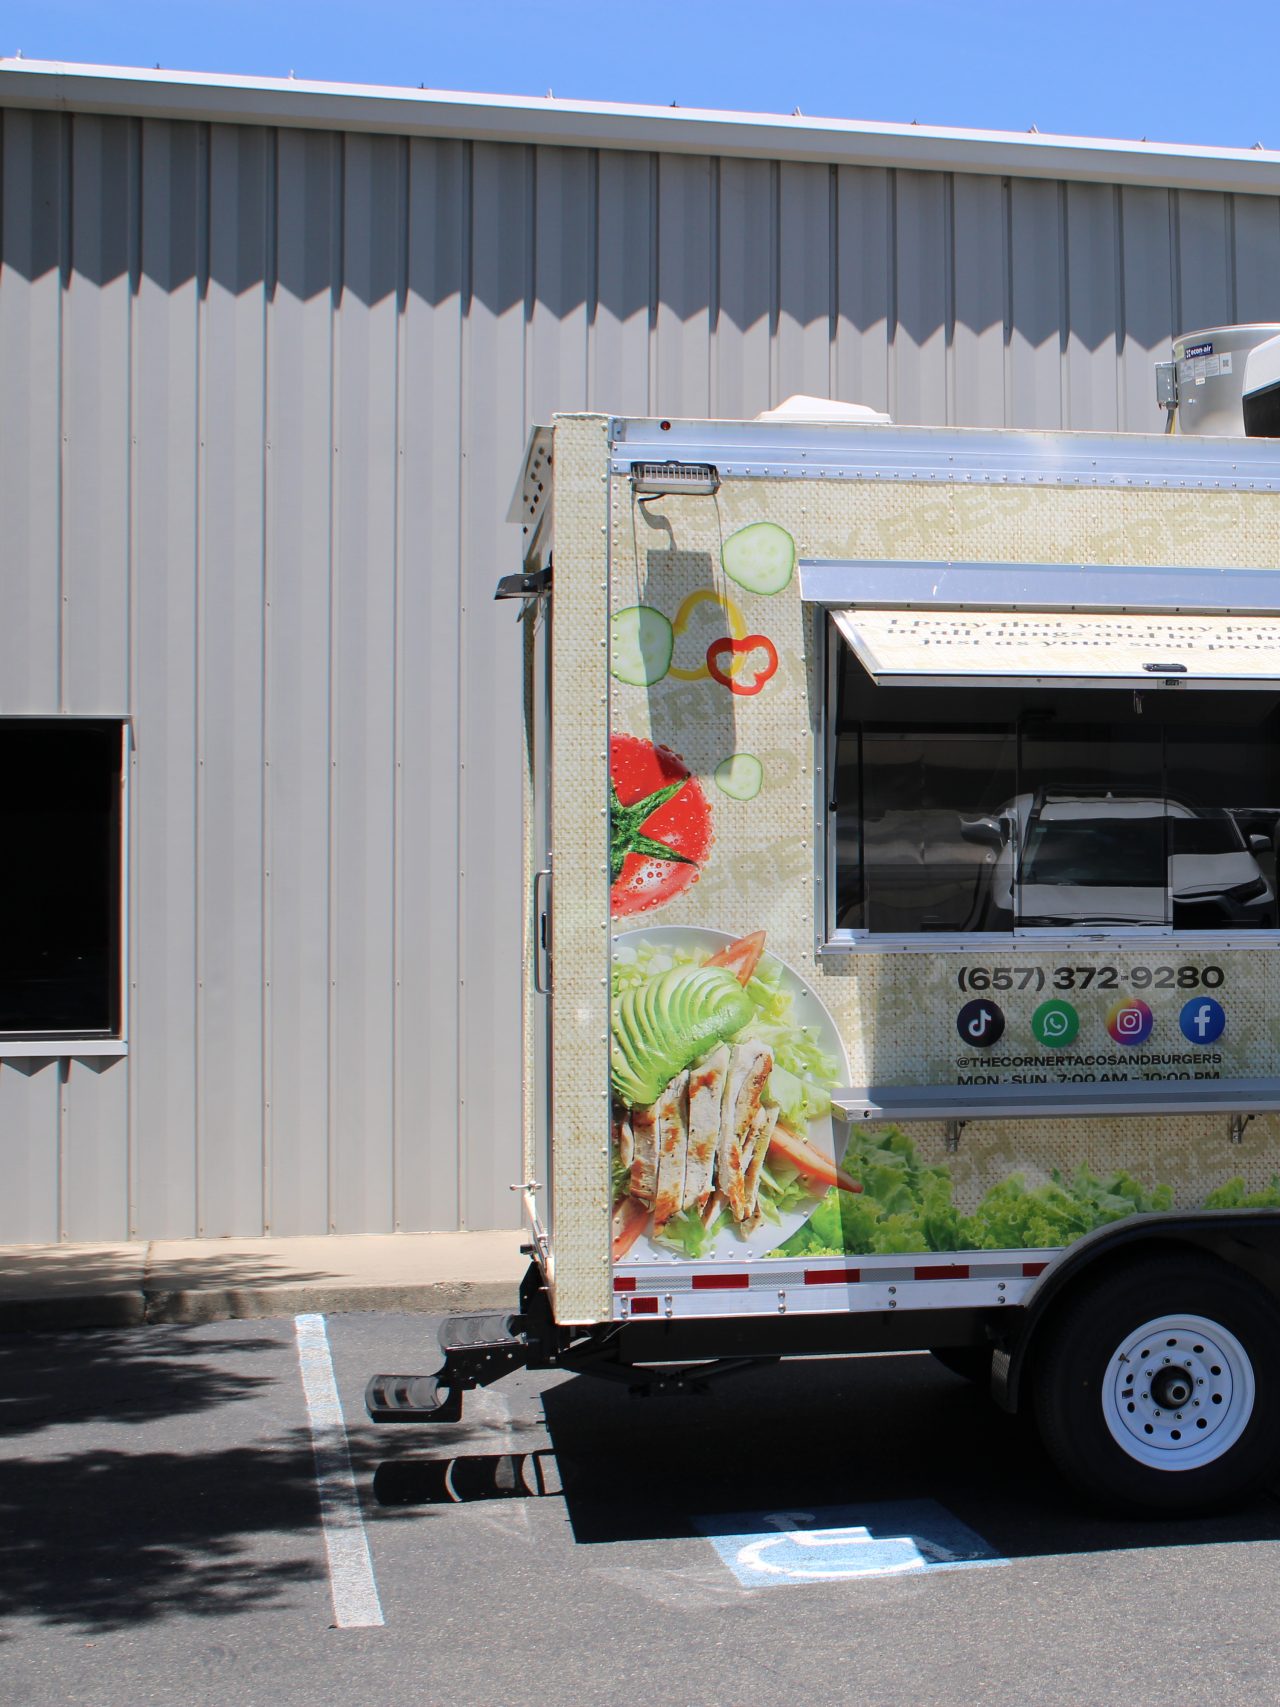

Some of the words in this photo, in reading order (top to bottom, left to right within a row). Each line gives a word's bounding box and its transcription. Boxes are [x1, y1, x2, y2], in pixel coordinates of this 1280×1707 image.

[1146, 625, 1214, 633] may
[1041, 640, 1117, 648] your
[956, 966, 1045, 993] (657)
[1053, 965, 1225, 990] 372-9280
[956, 1053, 1222, 1069] @THECORNERTACOSANDBURGERS
[957, 1074, 1000, 1085] MON
[1011, 1073, 1047, 1084] SUN
[1056, 1073, 1096, 1083] 7:00
[1099, 1072, 1128, 1082] AM
[1142, 1071, 1190, 1081] 10:00
[1194, 1071, 1220, 1080] PM
